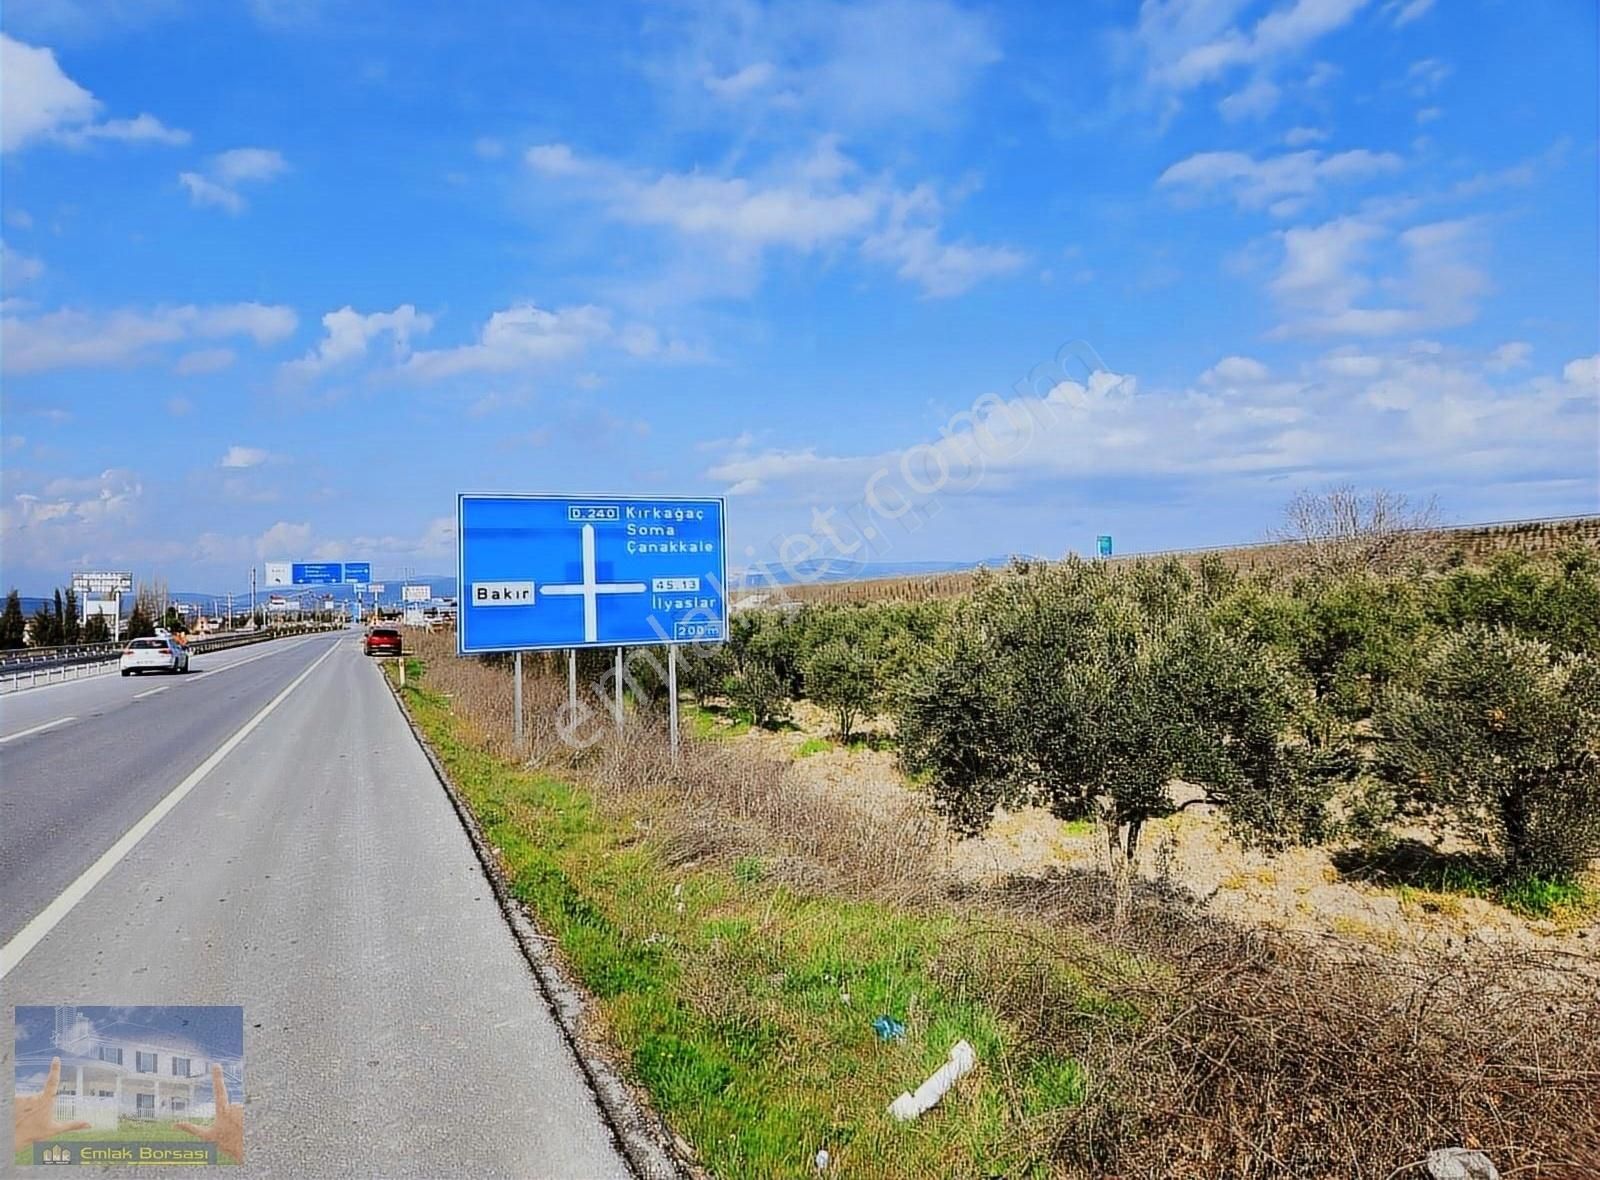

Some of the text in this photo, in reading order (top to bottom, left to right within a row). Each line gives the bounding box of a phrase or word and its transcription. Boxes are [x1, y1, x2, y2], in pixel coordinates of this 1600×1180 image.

[571, 508, 615, 519] D.240
[625, 506, 704, 521] Kırkağaç
[626, 523, 675, 536] Soma
[626, 541, 714, 554] Çanakkale
[476, 587, 530, 601] Bakır
[678, 625, 705, 636] 200
